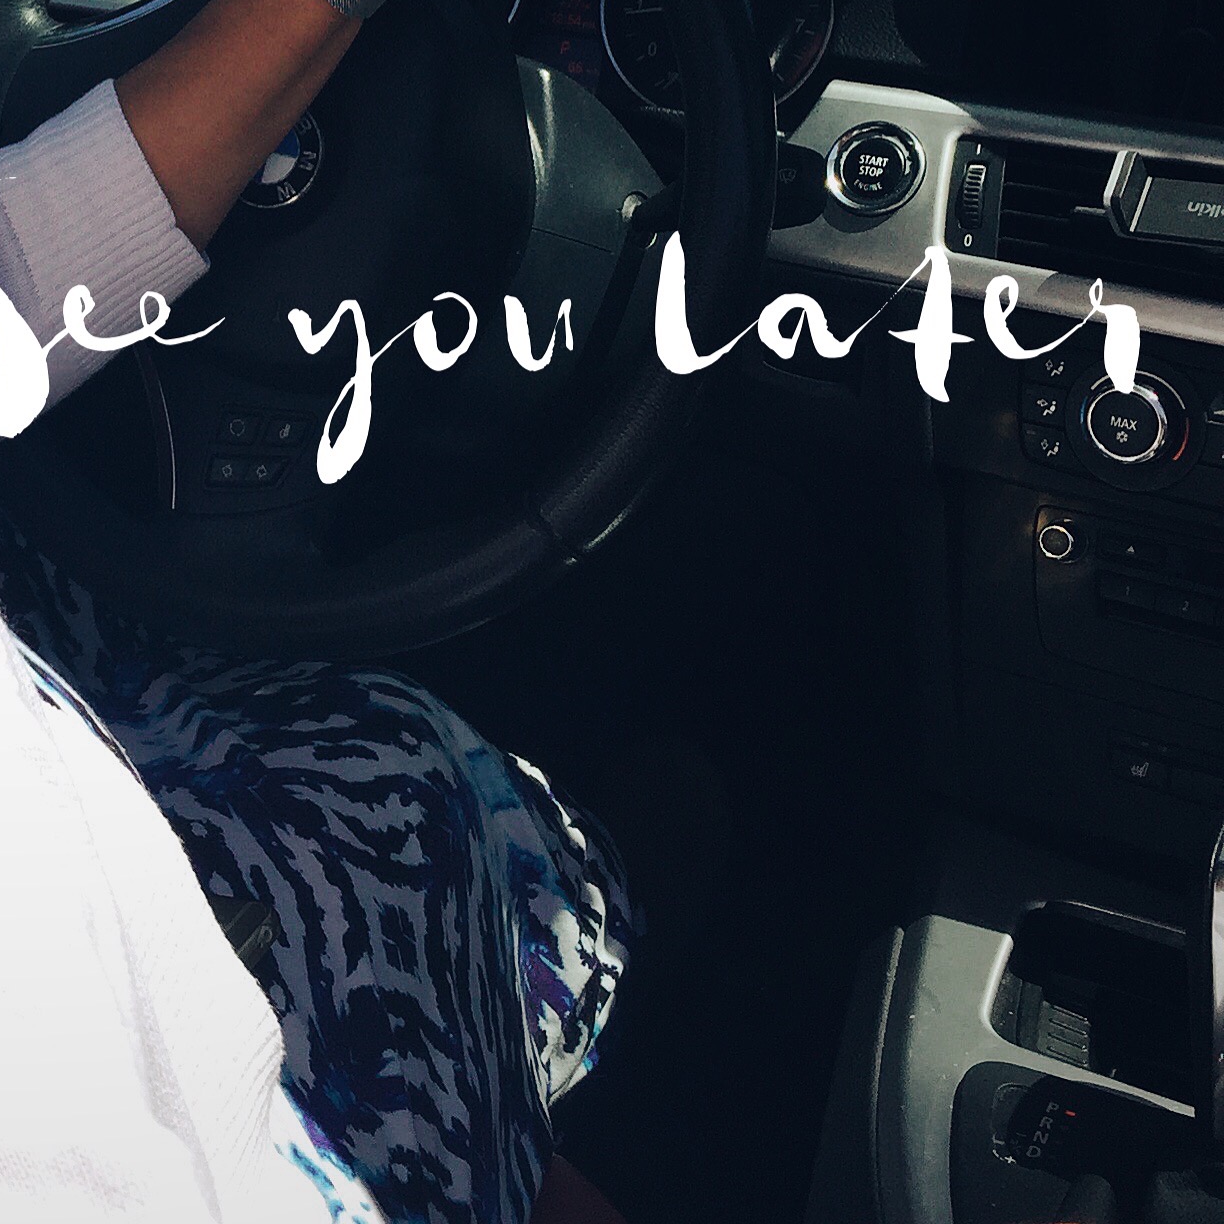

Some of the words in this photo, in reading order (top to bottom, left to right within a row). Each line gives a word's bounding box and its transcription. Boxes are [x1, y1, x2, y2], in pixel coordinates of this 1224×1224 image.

[795, 19, 806, 33] 7
[859, 154, 889, 168] START
[859, 165, 884, 178] STOP
[853, 179, 883, 191] ENGINE
[1110, 415, 1138, 431] MAX
[1046, 1102, 1059, 1113] P
[1040, 1116, 1053, 1129] R
[1033, 1131, 1048, 1144] N
[1026, 1145, 1041, 1158] D
